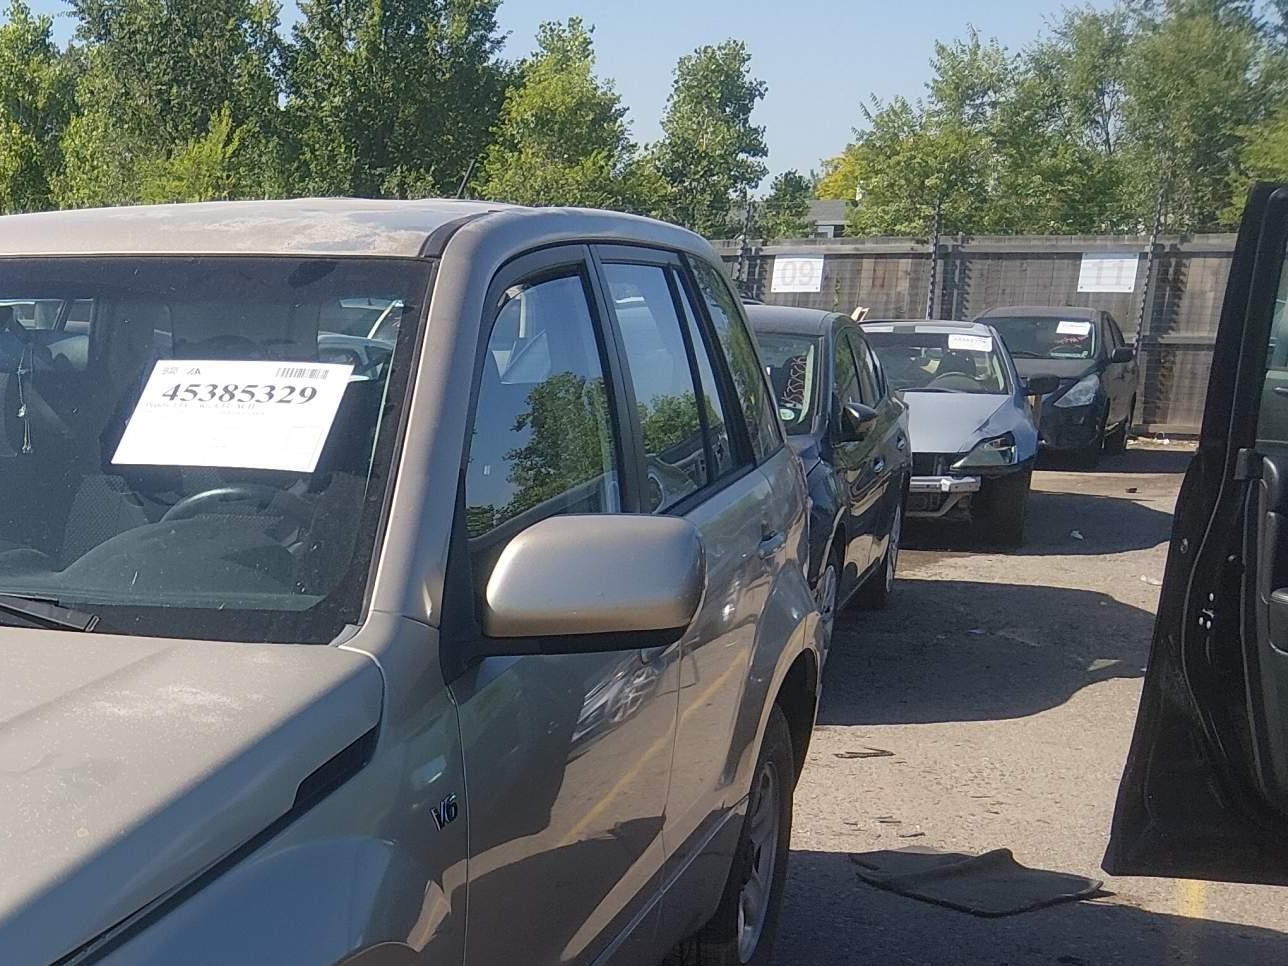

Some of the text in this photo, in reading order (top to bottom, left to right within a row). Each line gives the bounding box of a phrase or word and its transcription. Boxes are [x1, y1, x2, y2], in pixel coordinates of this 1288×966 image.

[780, 261, 815, 286] 09
[161, 382, 318, 405] 45385329
[429, 792, 458, 832] V6
